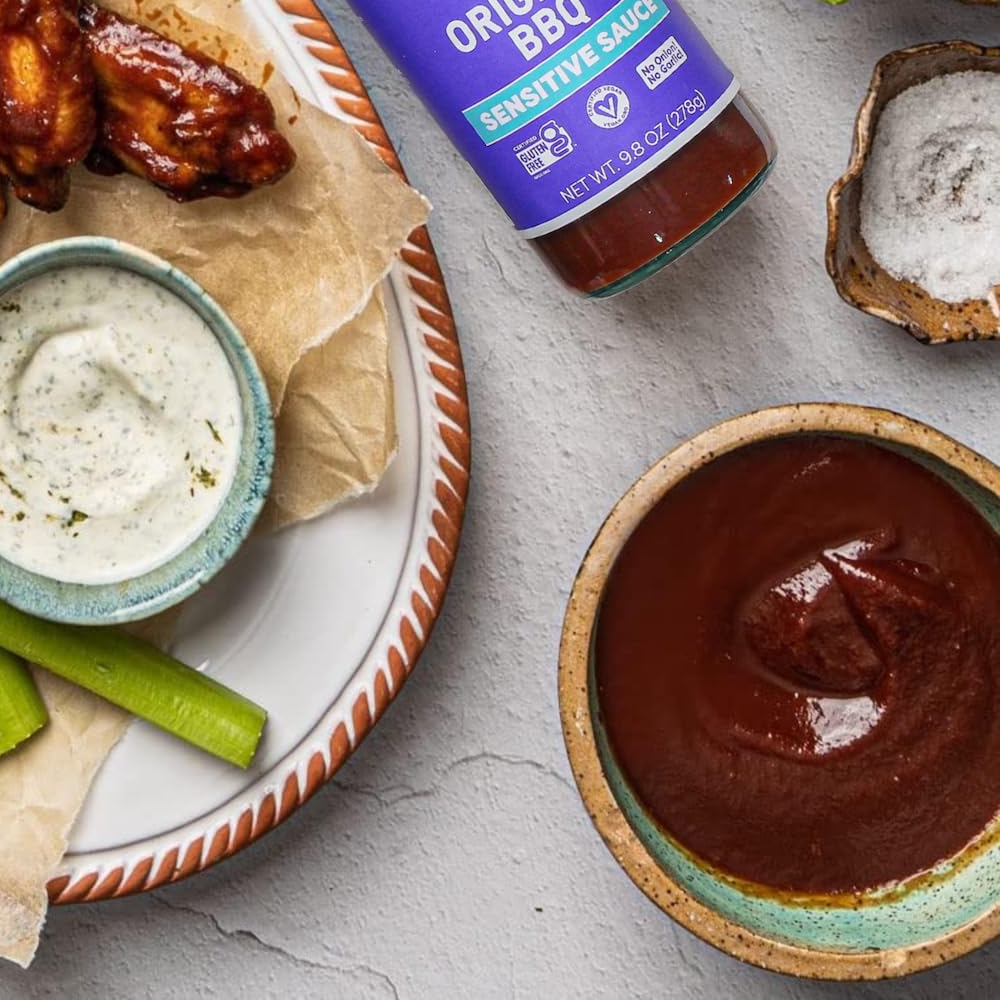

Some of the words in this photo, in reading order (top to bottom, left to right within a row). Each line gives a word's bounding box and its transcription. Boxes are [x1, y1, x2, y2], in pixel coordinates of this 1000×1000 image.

[641, 65, 655, 77] No
[654, 40, 678, 65] Onion!
[647, 72, 661, 85] No
[660, 49, 684, 74] Garlic!
[479, 43, 600, 132] SENSITIVE
[588, 88, 602, 117] CERTIFIED
[603, 86, 622, 95] VEGAN
[519, 141, 549, 163] GLUTEN
[560, 176, 592, 204] NET
[591, 165, 621, 186] WT.
[618, 141, 645, 167] 9.8
[644, 124, 669, 146] OZ
[665, 88, 708, 131] (278g)
[526, 157, 545, 174] FREE
